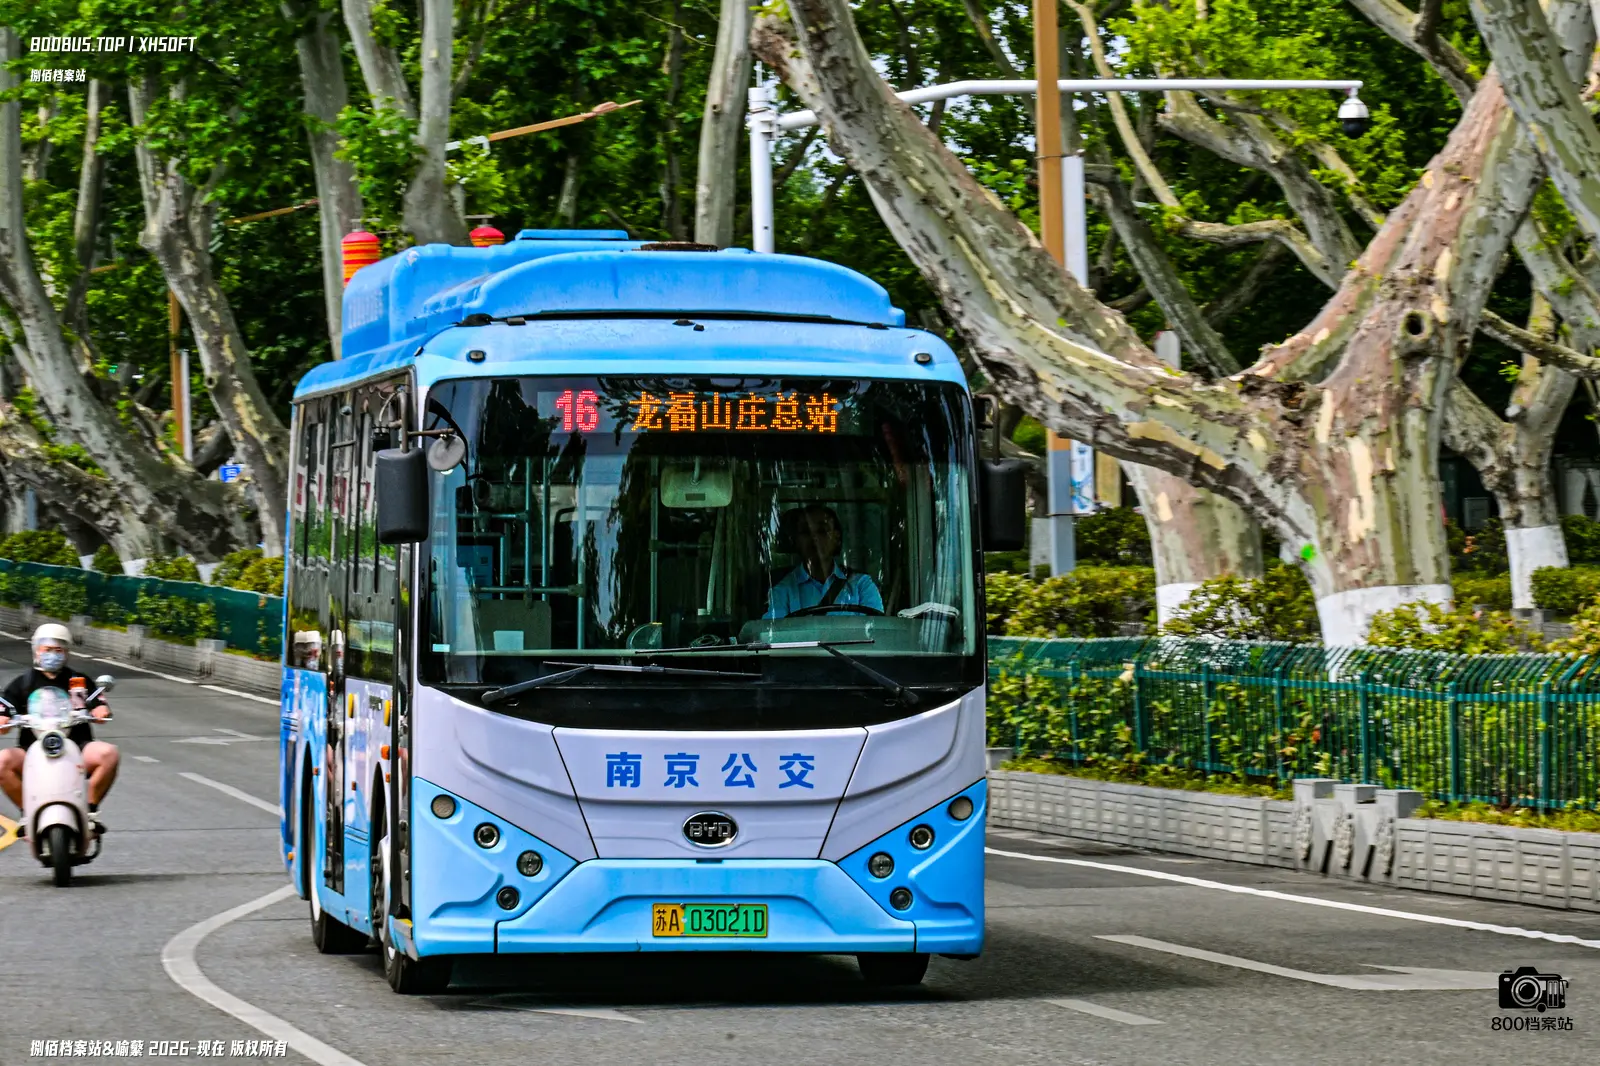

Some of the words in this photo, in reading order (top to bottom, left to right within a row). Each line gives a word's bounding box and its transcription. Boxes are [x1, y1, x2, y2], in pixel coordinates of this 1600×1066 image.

[556, 389, 599, 431] 16
[629, 391, 838, 432] 龙福山庄总站
[605, 751, 815, 789] 南京公交
[688, 821, 732, 838] BYD
[655, 908, 680, 932] 苏A
[690, 908, 765, 933] 03021D
